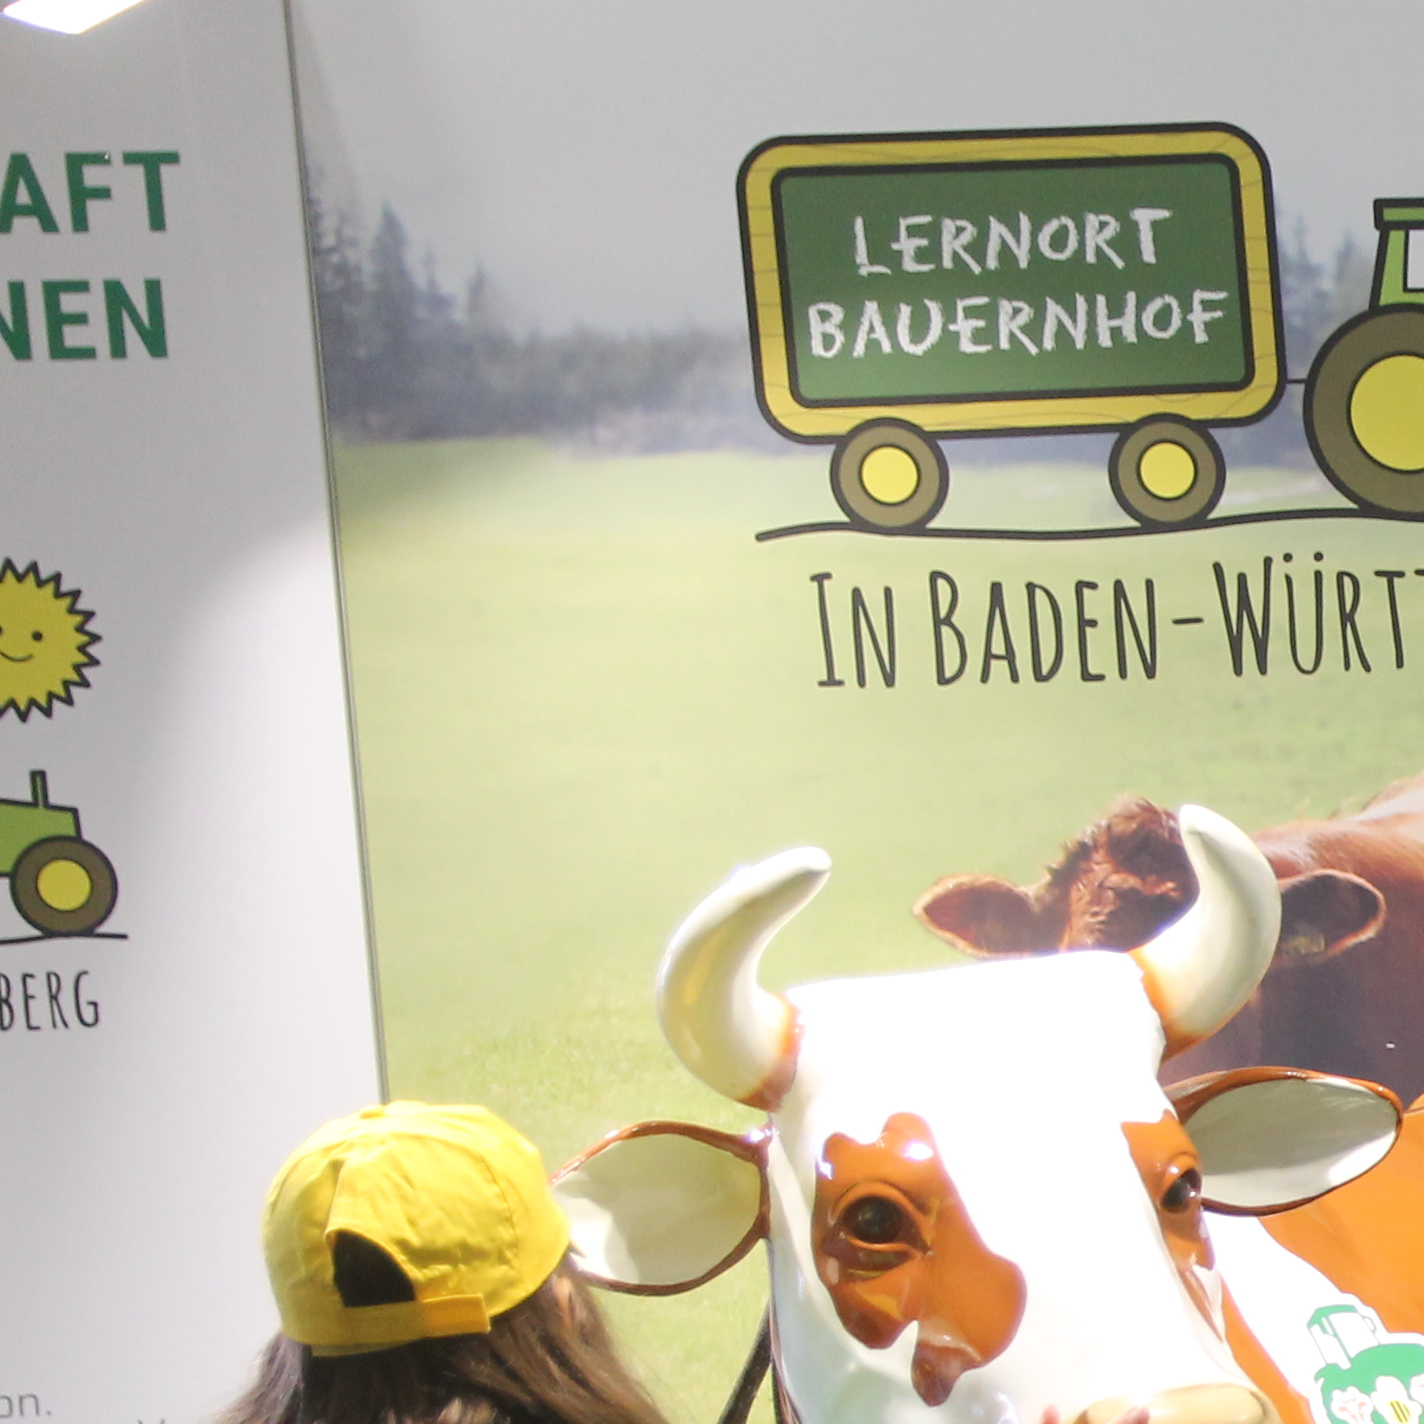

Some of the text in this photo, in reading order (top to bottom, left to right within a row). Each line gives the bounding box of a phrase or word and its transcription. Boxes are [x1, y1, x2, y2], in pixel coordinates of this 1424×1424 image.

[0, 150, 180, 233] AFT
[853, 208, 1173, 276] LERNORT
[807, 288, 1230, 358] BAUERNHOF
[0, 970, 99, 1031] BERG
